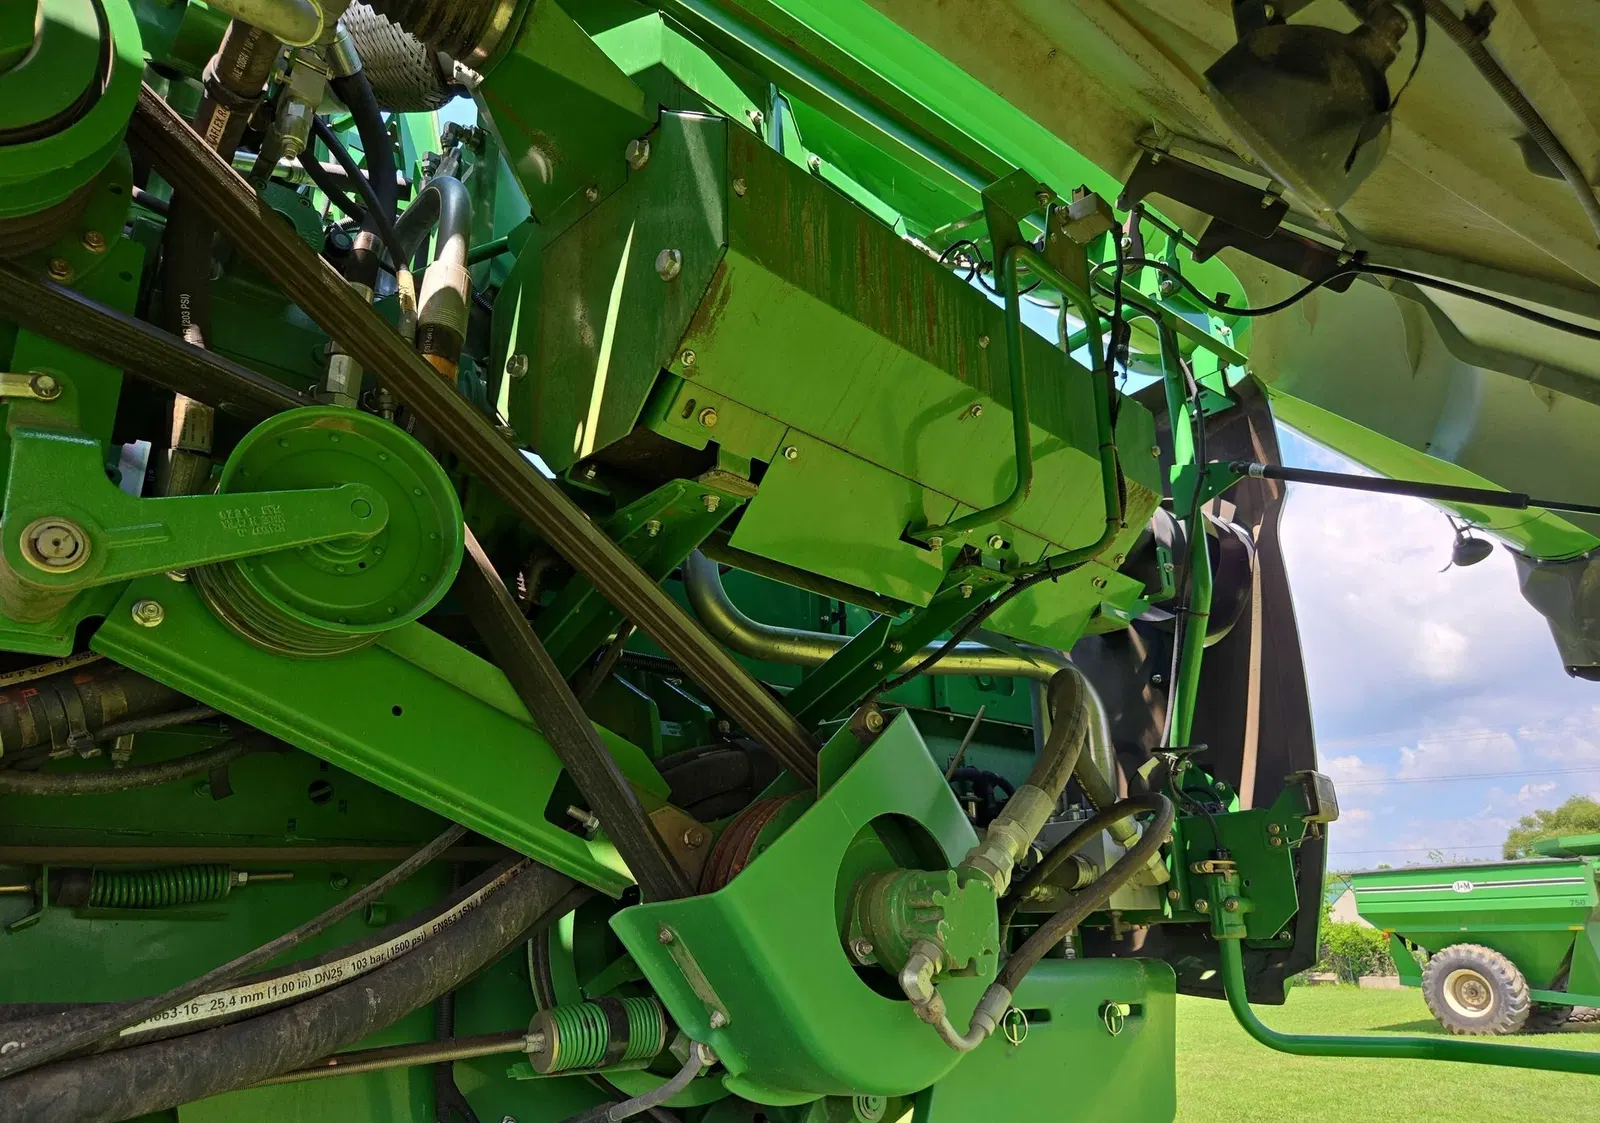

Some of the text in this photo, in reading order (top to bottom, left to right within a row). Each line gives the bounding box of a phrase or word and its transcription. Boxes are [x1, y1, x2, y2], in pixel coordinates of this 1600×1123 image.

[180, 293, 190, 310] PSI)
[181, 310, 191, 326] (203
[209, 995, 237, 1011] 25.4
[240, 991, 263, 1005] mm
[267, 981, 295, 999] (1.00
[298, 976, 312, 990] in)
[314, 967, 343, 984] DN25
[351, 958, 367, 971] 103
[369, 953, 384, 965] bar
[387, 939, 409, 958] (1500
[411, 931, 427, 948] psi)
[432, 913, 457, 934] EN853
[458, 902, 474, 919] 1SN
